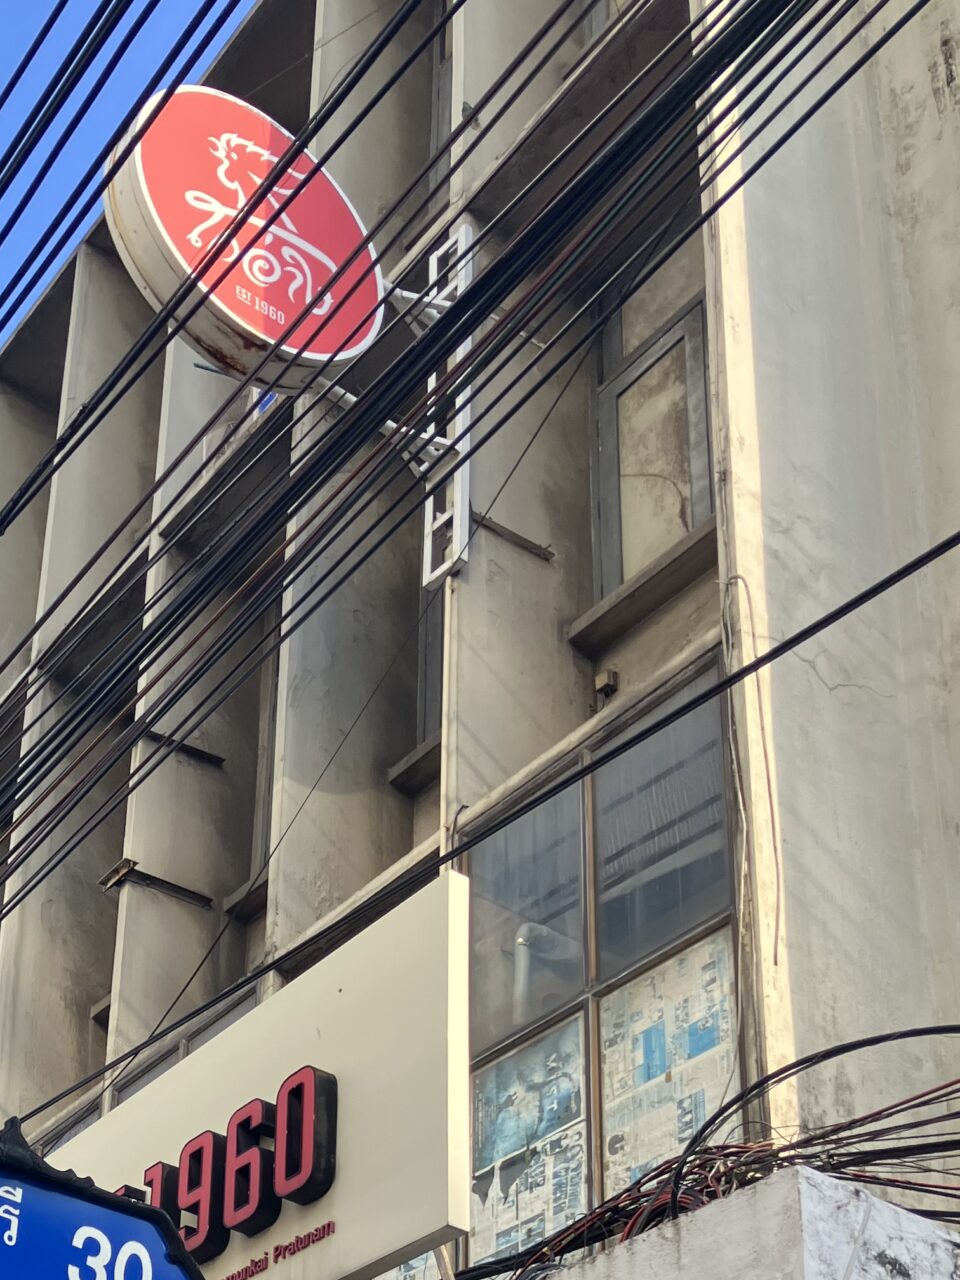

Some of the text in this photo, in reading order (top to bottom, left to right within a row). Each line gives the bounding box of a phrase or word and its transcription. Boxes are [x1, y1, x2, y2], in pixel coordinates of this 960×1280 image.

[253, 296, 285, 325] 1960
[144, 1065, 338, 1264] 1960
[273, 1220, 336, 1264] Pratunam
